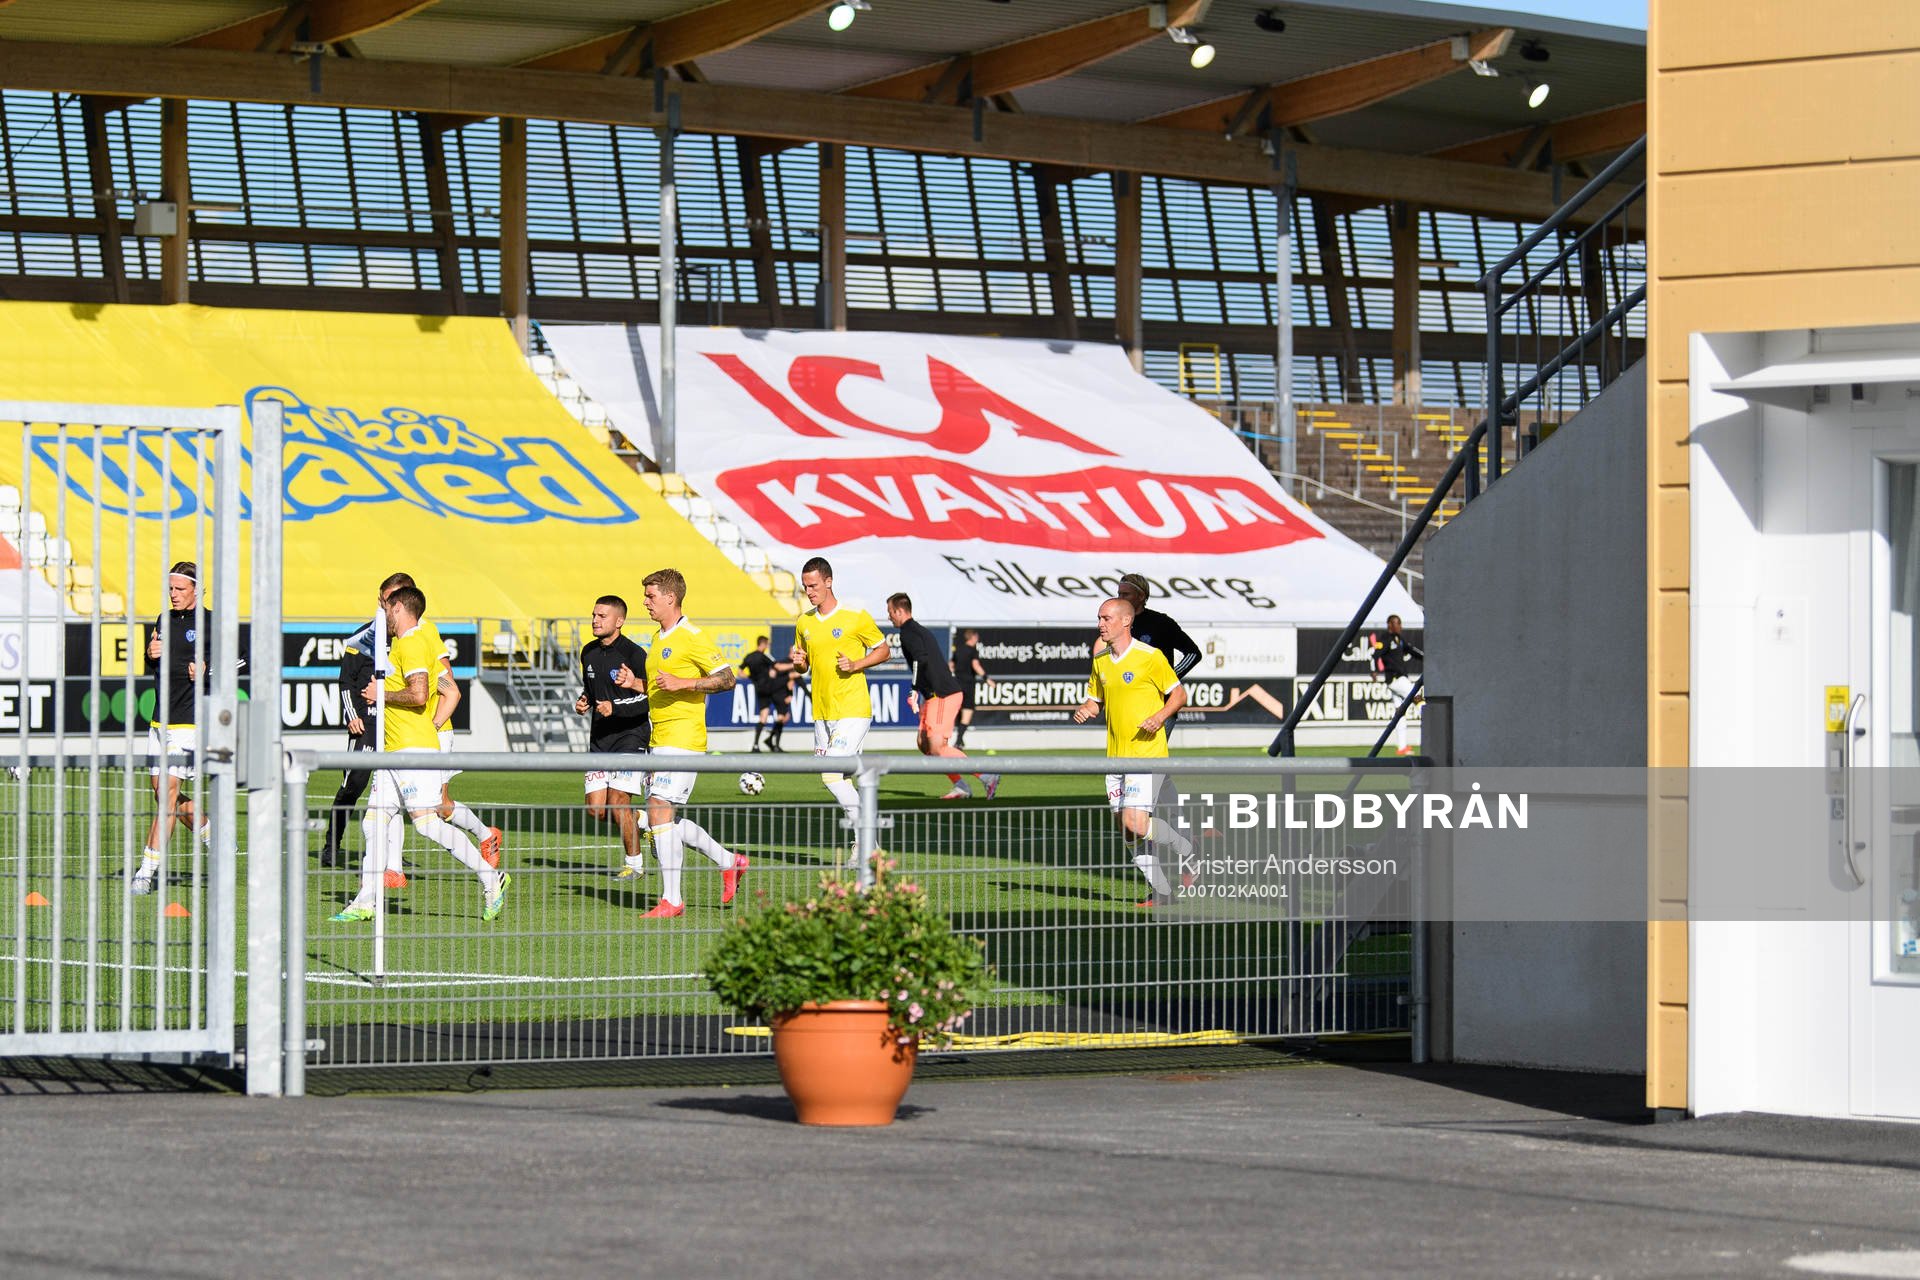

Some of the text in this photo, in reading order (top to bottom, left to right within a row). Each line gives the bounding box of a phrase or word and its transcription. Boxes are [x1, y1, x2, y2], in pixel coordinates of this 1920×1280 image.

[699, 351, 1121, 457] ICA
[756, 471, 1286, 539] KVANTUM
[1034, 641, 1091, 662] Sparbank
[974, 682, 1224, 707] HUSCENTRU YGG
